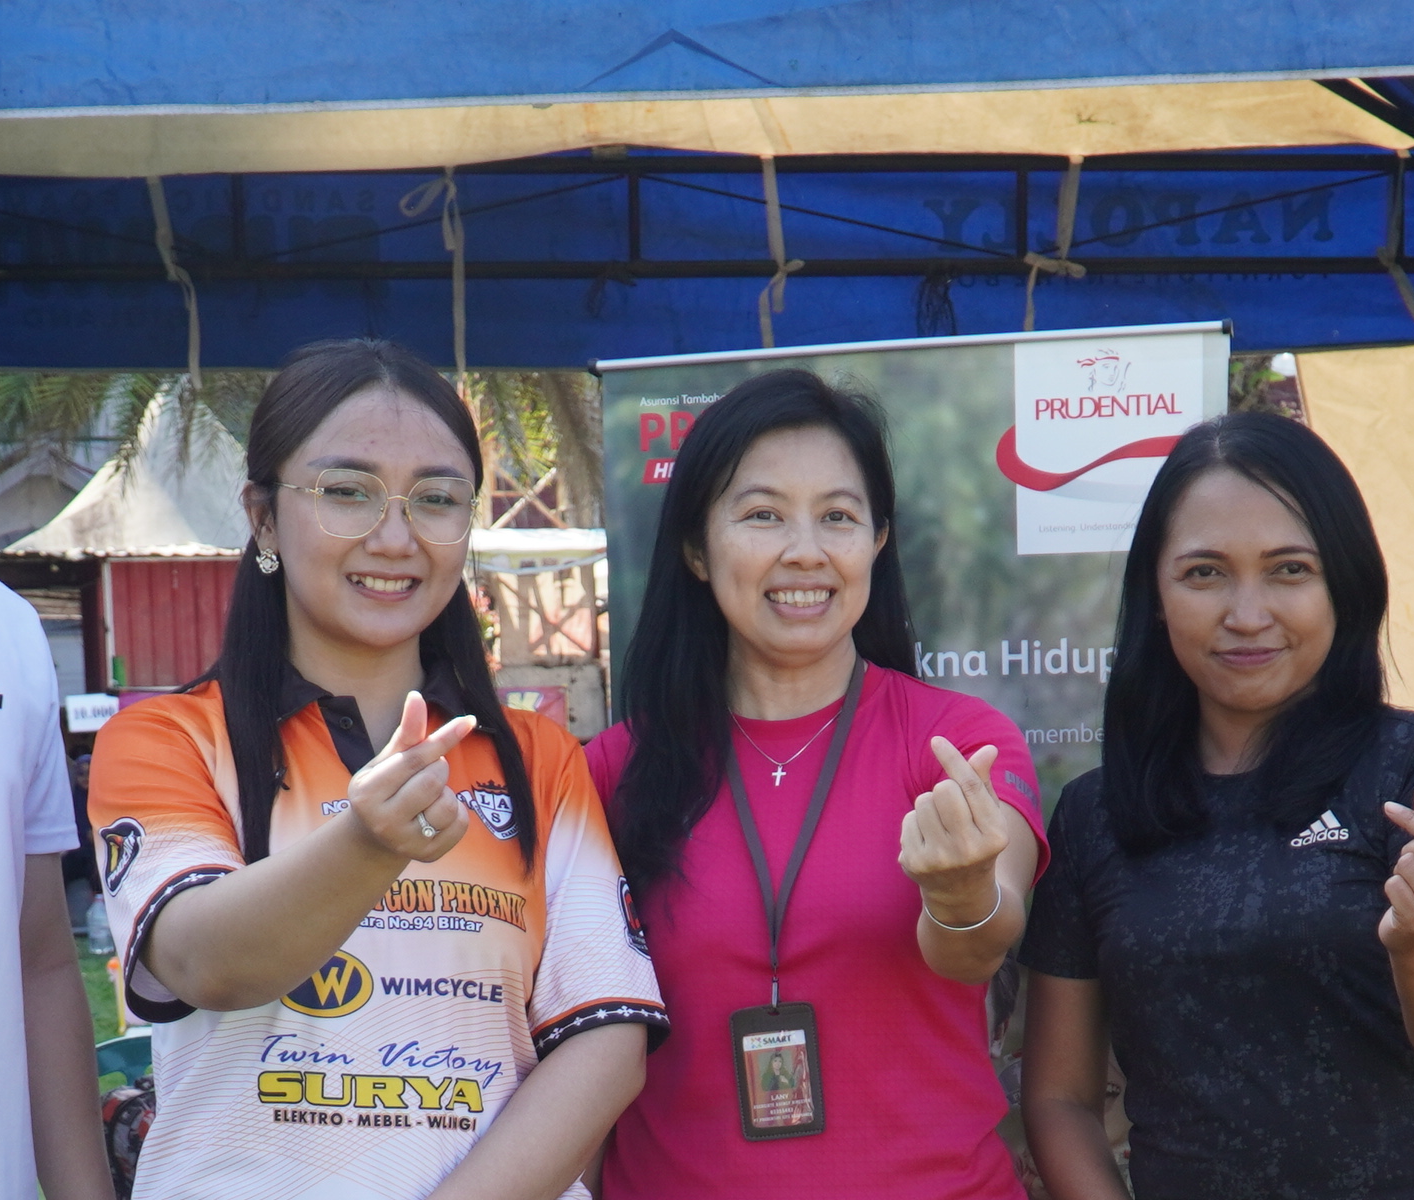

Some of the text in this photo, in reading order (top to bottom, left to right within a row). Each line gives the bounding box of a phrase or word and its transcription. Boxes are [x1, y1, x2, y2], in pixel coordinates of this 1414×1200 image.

[639, 396, 680, 407] Asuransi
[1035, 392, 1183, 421] PRUDENTIAL
[1290, 826, 1350, 848] adidas
[438, 880, 527, 933] PHOENIX
[388, 915, 434, 931] No.94
[437, 915, 484, 933] Blitar
[380, 976, 504, 1004] WIMCYCLE
[762, 1034, 792, 1045] SMART
[260, 1033, 504, 1090] Twin Victory
[257, 1070, 484, 1114] SURYA
[273, 1108, 344, 1126] ELEKTRO
[356, 1114, 412, 1128] MEBEL
